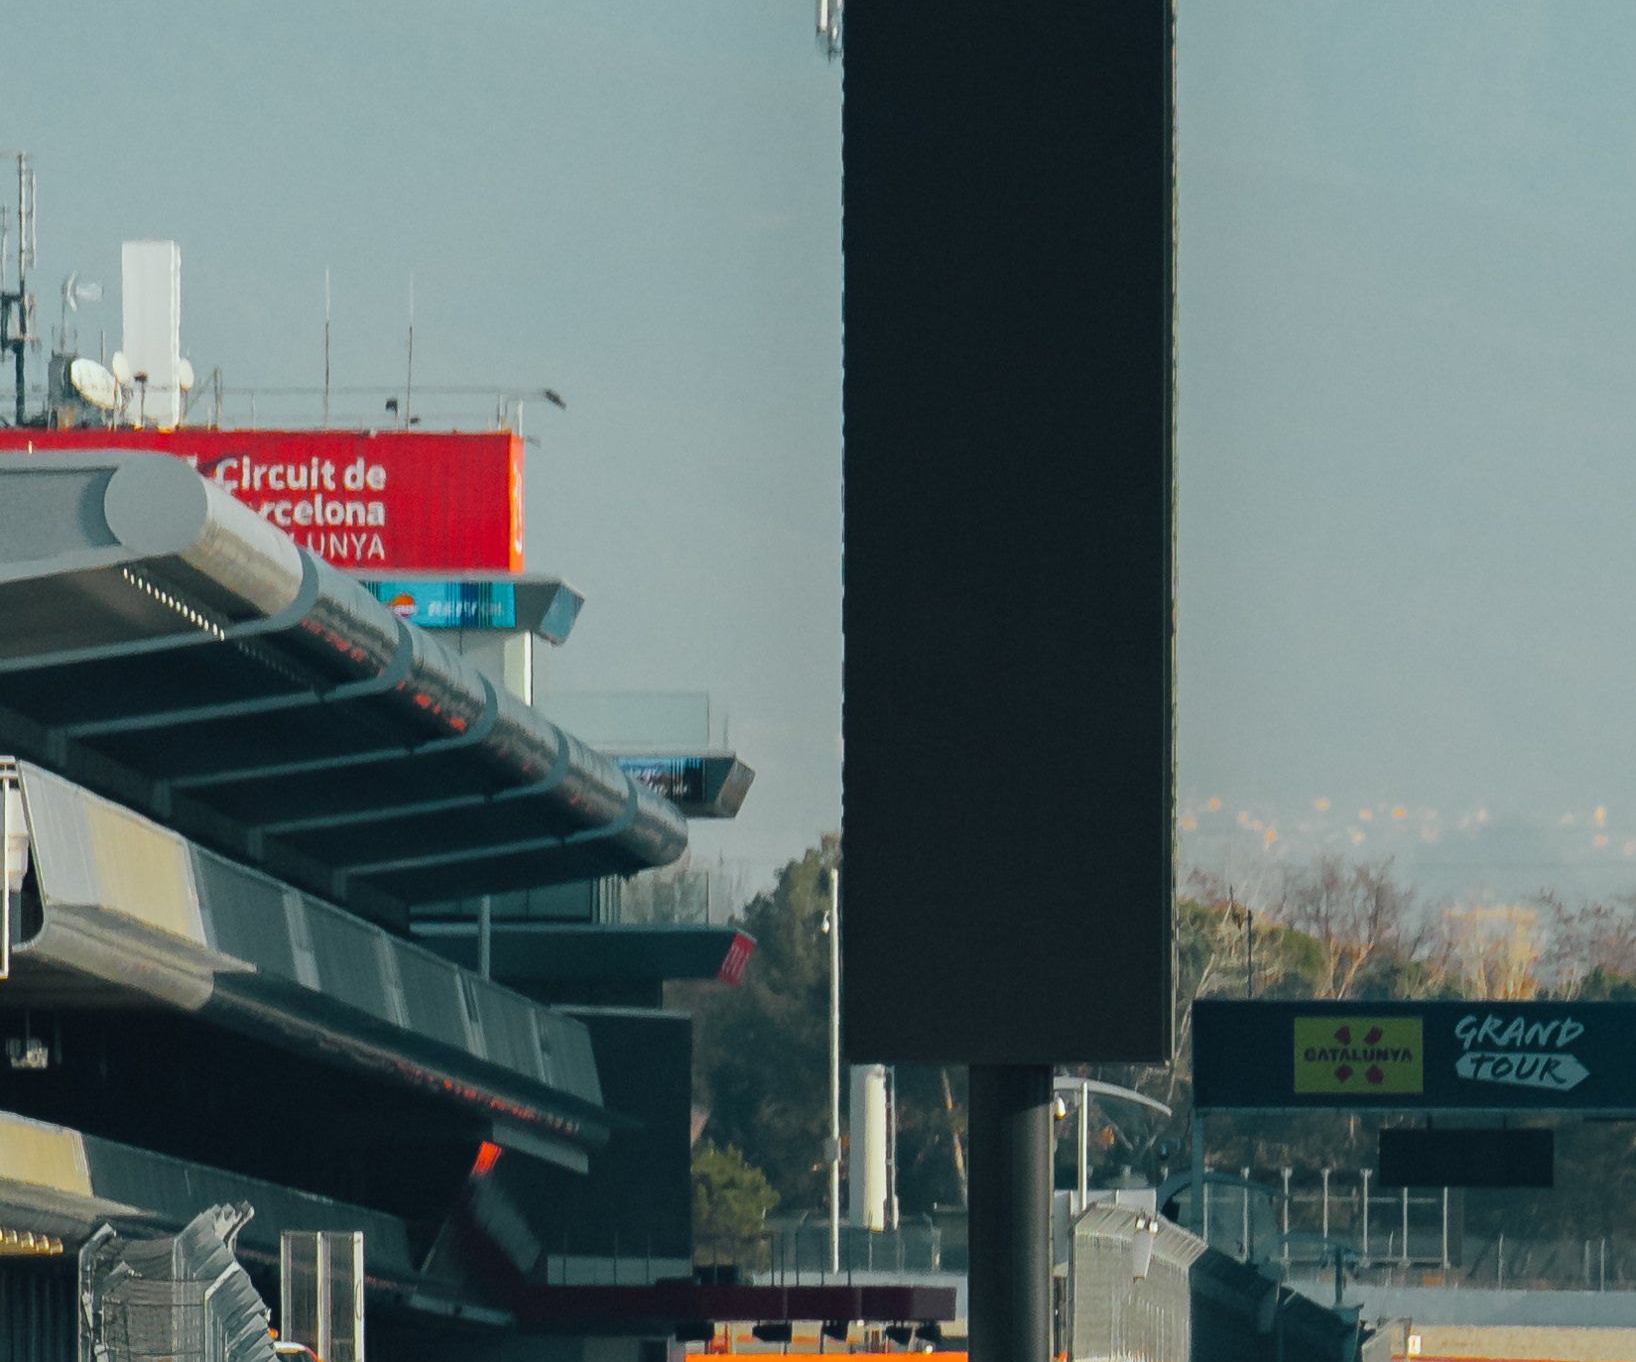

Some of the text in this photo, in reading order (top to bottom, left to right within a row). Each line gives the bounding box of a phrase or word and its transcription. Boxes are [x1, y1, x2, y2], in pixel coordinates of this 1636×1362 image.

[215, 455, 387, 491] Circuit de
[259, 493, 386, 527] rcelona
[1454, 1013, 1586, 1051] GRAND
[1303, 1046, 1414, 1064] CATALUNYA
[1470, 1053, 1568, 1085] TOUR
